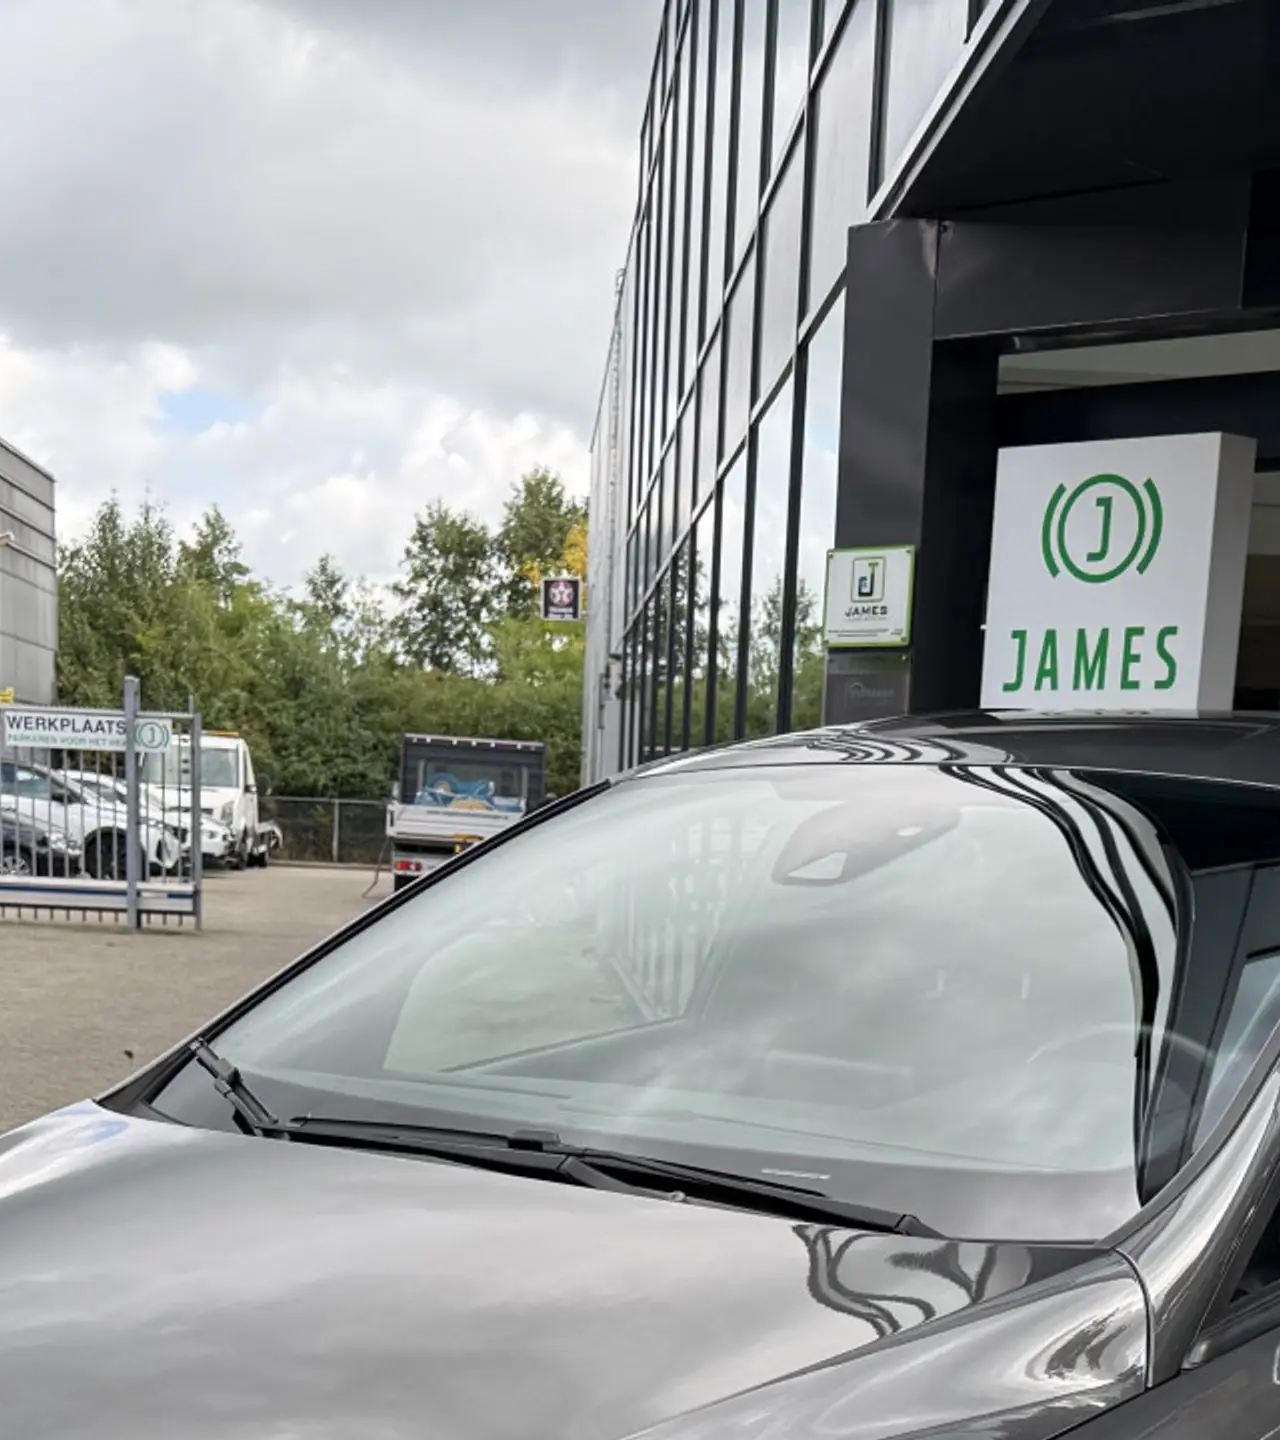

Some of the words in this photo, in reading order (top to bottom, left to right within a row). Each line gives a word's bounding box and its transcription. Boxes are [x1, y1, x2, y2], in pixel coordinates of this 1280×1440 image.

[844, 606, 888, 617] JAMES
[1002, 626, 1179, 692] JAMES
[7, 715, 127, 736] WERKPLAATS
